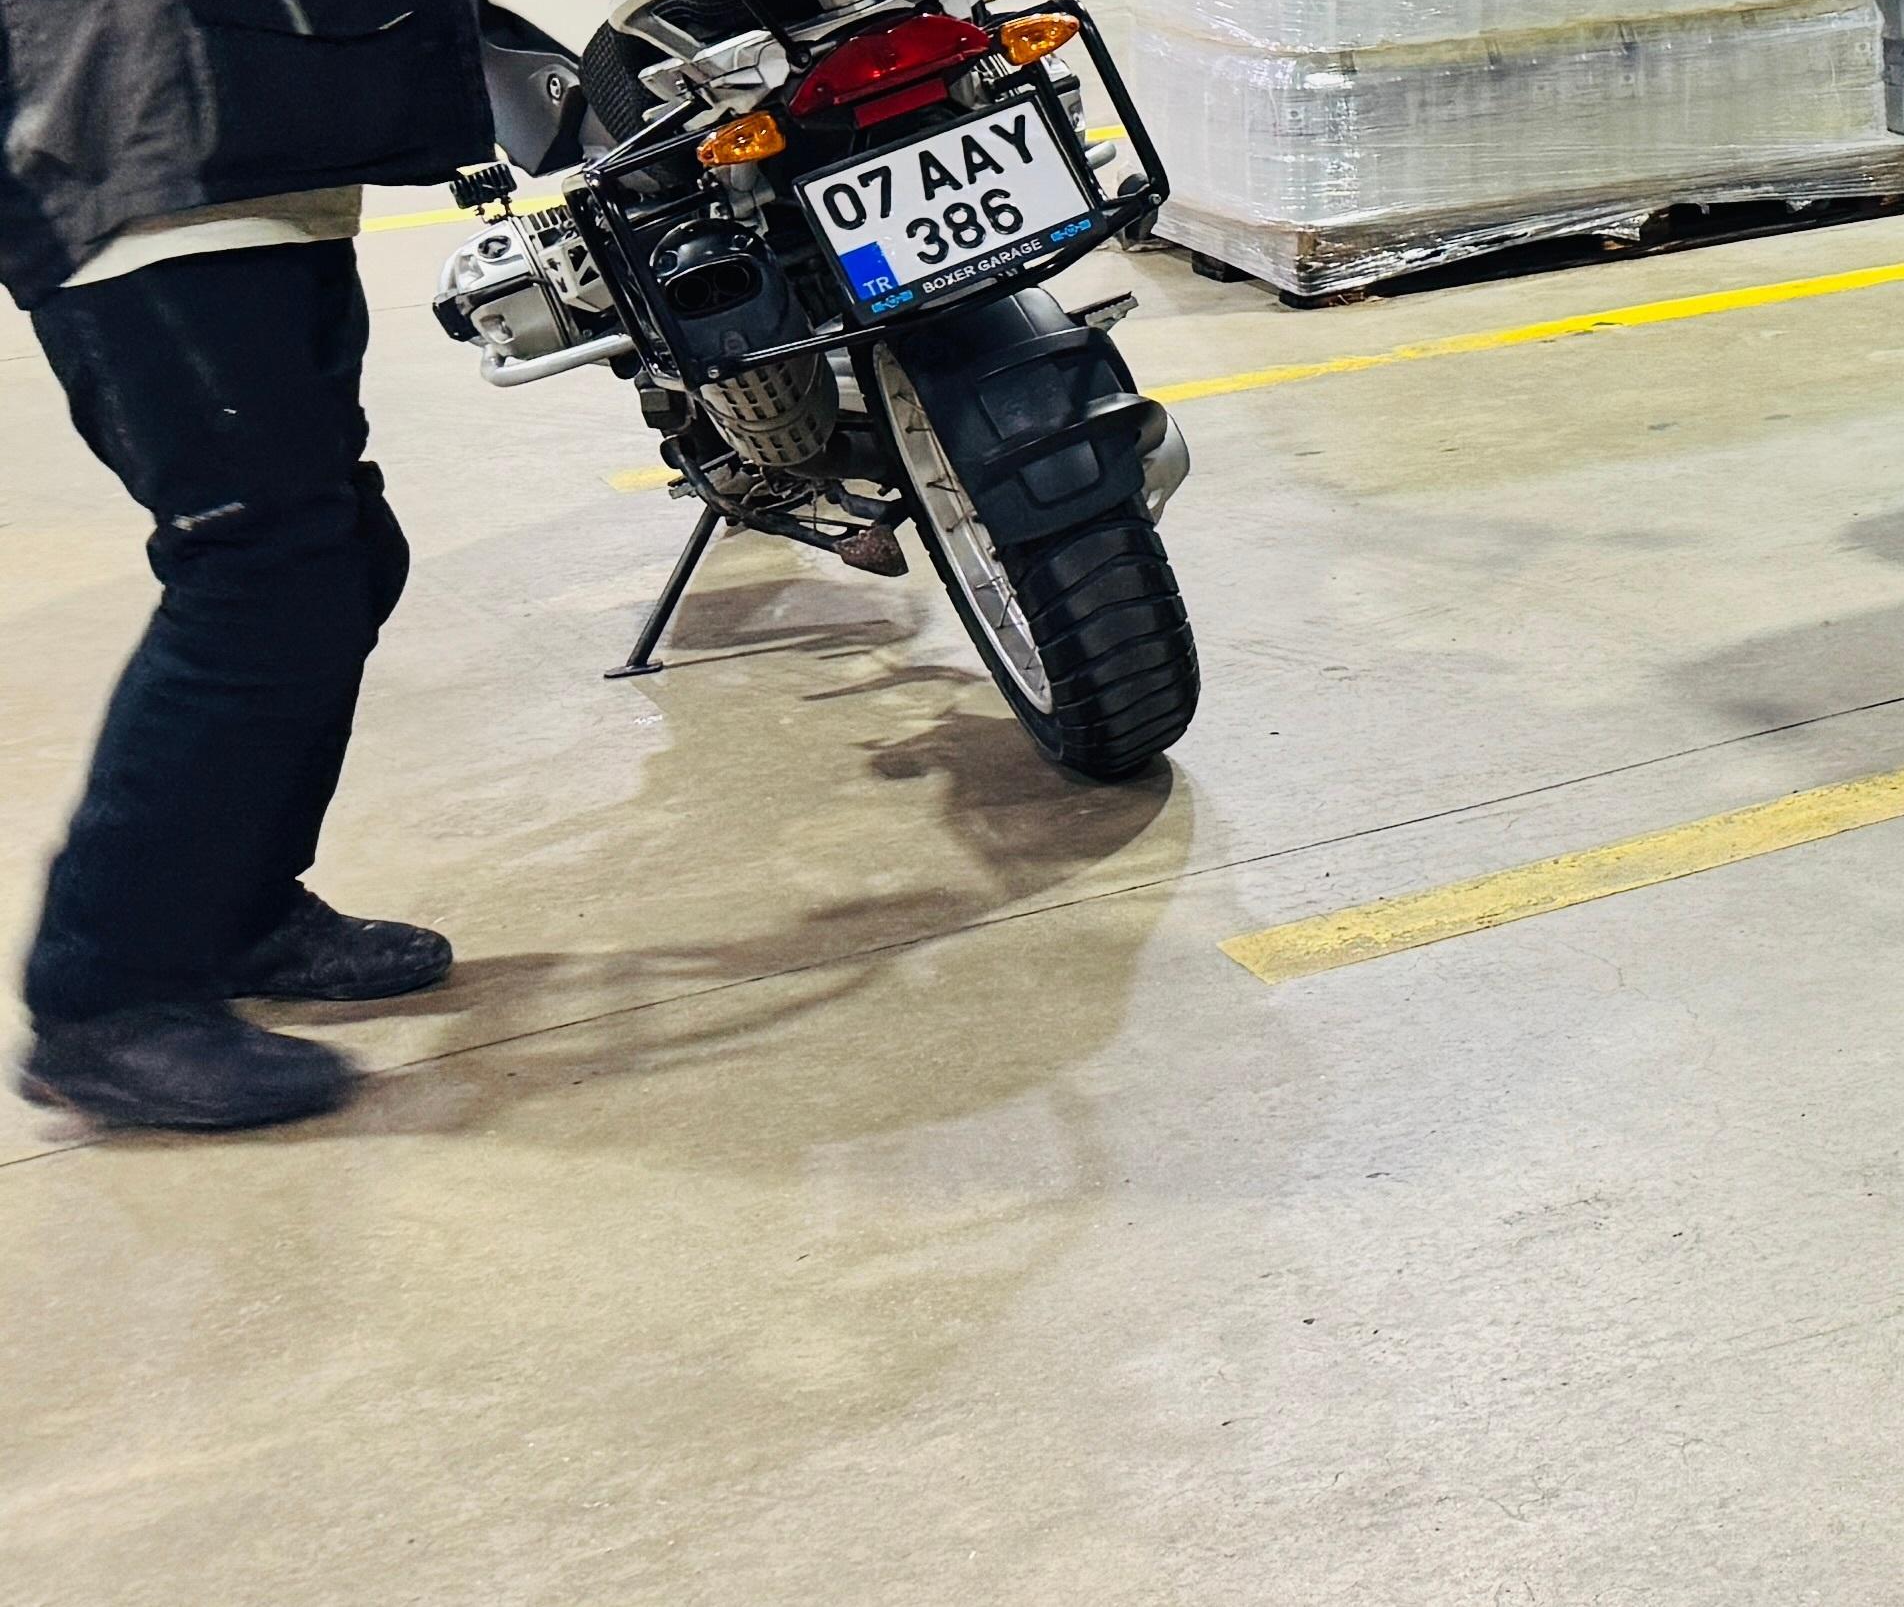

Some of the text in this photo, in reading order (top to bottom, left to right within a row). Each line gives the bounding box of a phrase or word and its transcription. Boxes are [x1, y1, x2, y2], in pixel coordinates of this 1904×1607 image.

[822, 114, 1033, 230] 07 AAY
[905, 188, 1024, 265] 386
[862, 276, 894, 297] TR
[922, 238, 1043, 294] BOXER GARAGE
